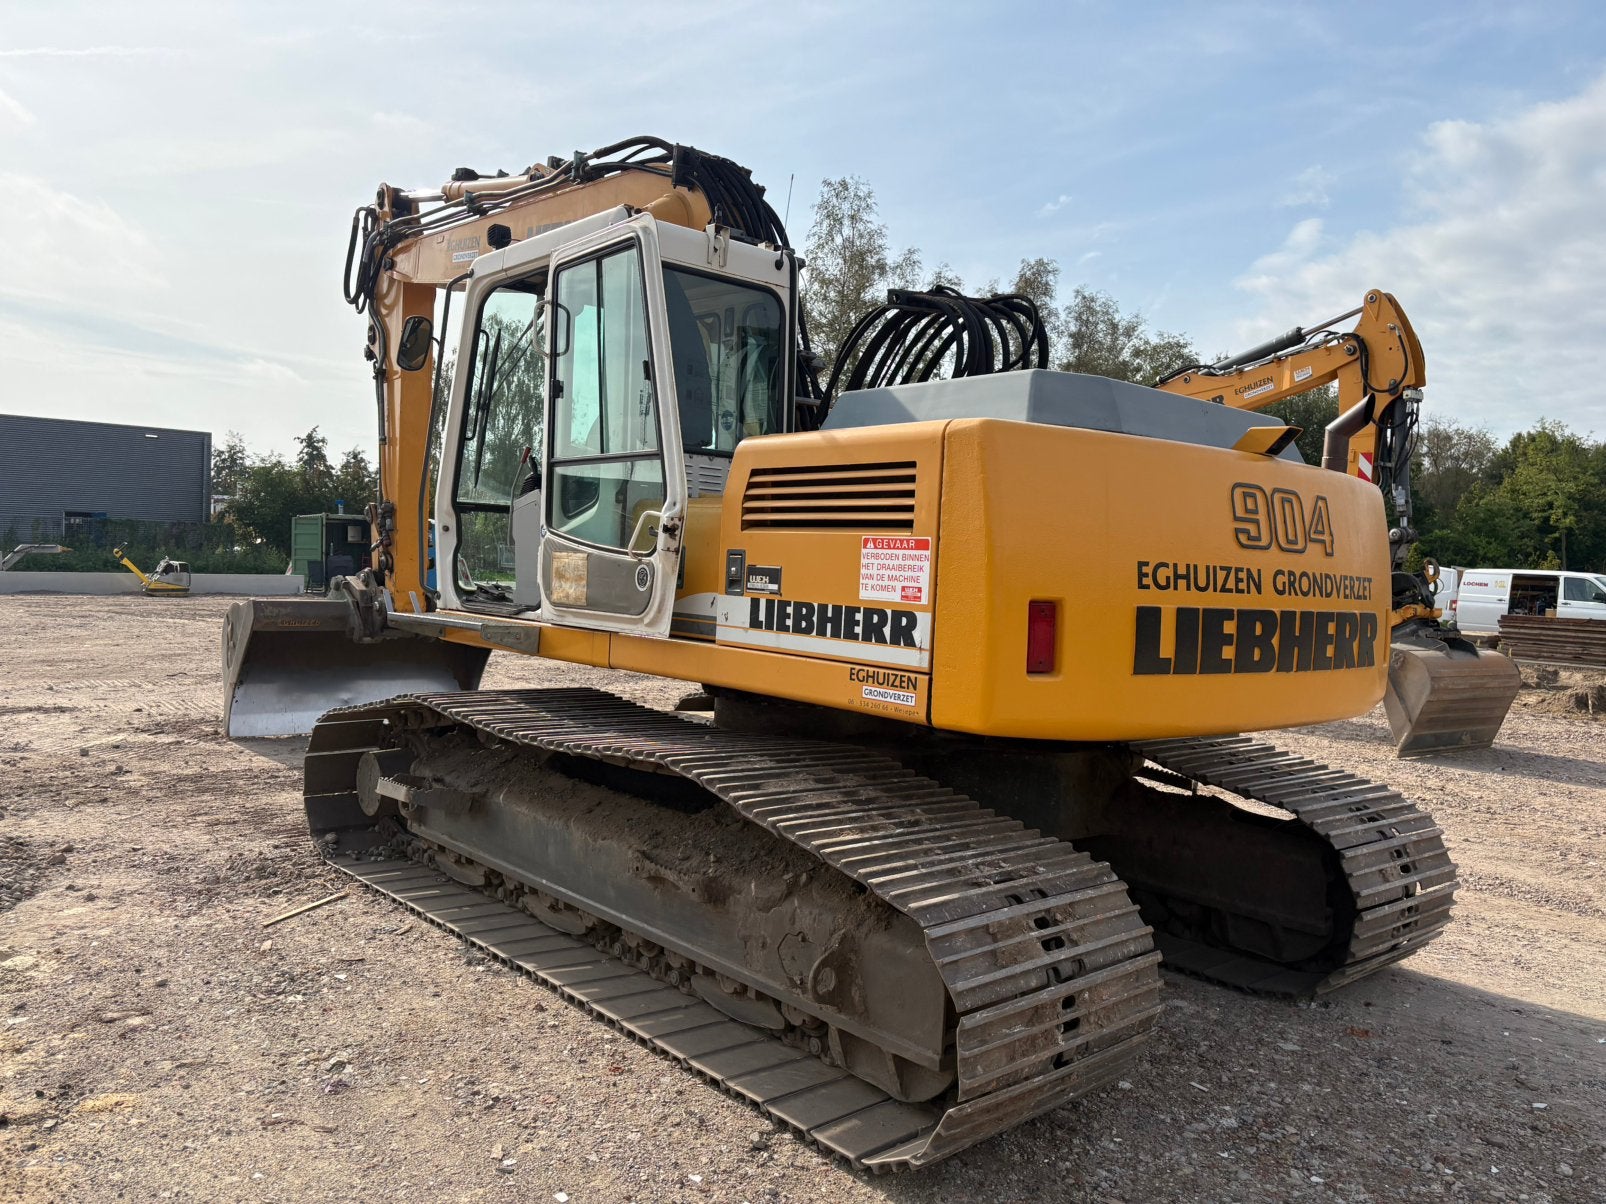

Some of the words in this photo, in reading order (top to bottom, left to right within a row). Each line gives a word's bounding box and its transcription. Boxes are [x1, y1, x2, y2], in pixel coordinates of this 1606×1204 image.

[1234, 376, 1274, 395] EGHUIZEN
[1231, 482, 1334, 557] 904
[876, 539, 915, 549] GEVAAR
[862, 552, 900, 561] VERBODEN
[902, 553, 930, 562] BINNEN
[862, 563, 875, 571] HET
[877, 563, 925, 573] DRAAIBEREIK
[861, 573, 874, 581] VAN
[876, 573, 886, 582] DE
[888, 574, 921, 583] MACHINE
[1137, 561, 1262, 595] EGHUIZEN
[1272, 569, 1372, 601] GRONDVERZET
[861, 583, 869, 591] TE
[870, 584, 897, 592] KOMEN
[750, 597, 918, 648] LIEBHERR
[1133, 606, 1378, 675] LIEBHERR
[849, 667, 918, 691] EGHUIZEN
[864, 688, 914, 704] GRONDVERZET
